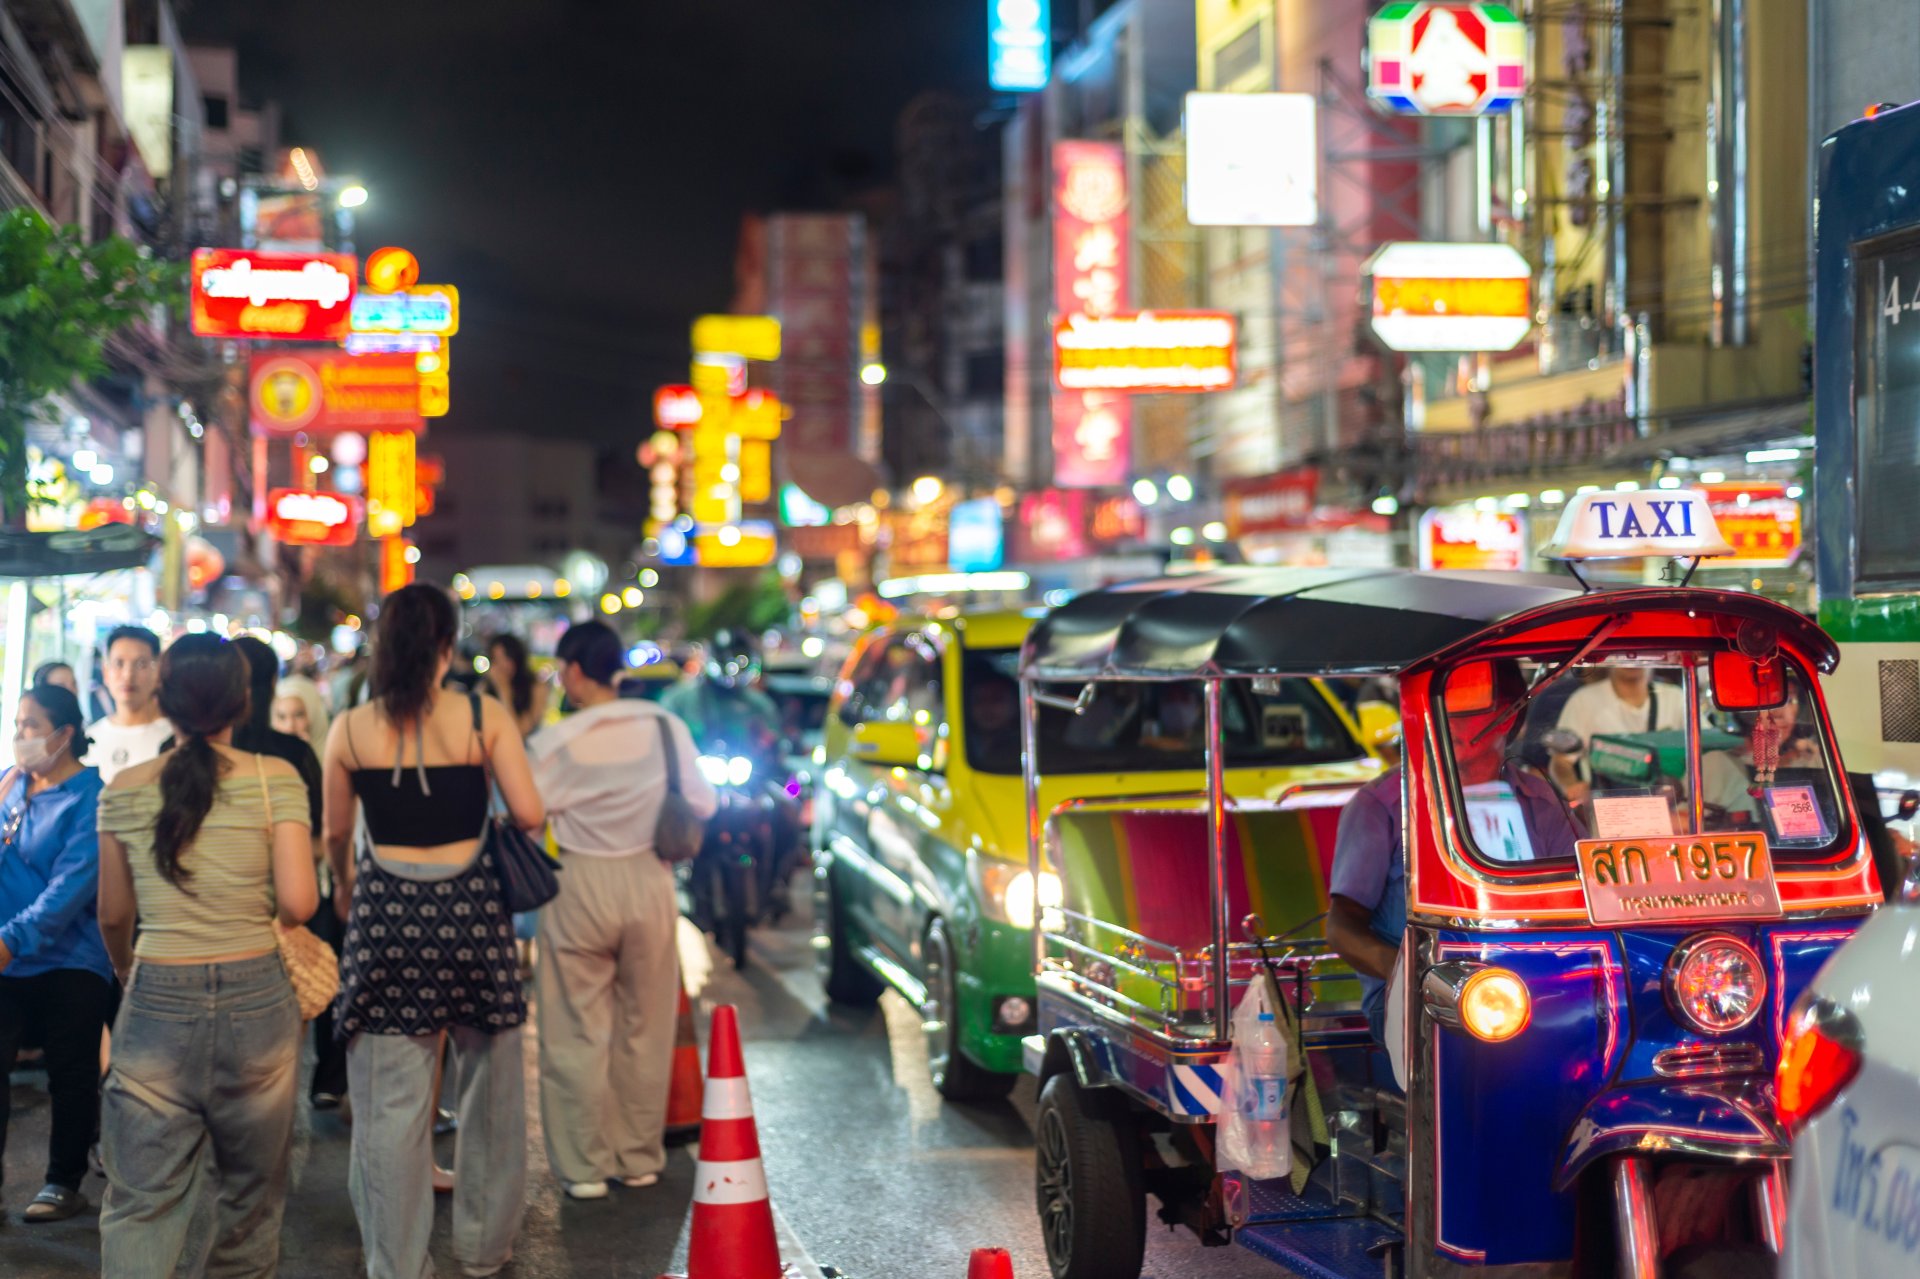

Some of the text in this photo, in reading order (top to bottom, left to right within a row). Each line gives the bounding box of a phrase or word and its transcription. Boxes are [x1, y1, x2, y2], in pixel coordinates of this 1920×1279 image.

[1589, 501, 1696, 538] TAXI
[1791, 801, 1813, 813] 2568
[1591, 841, 1758, 885] สก 1957
